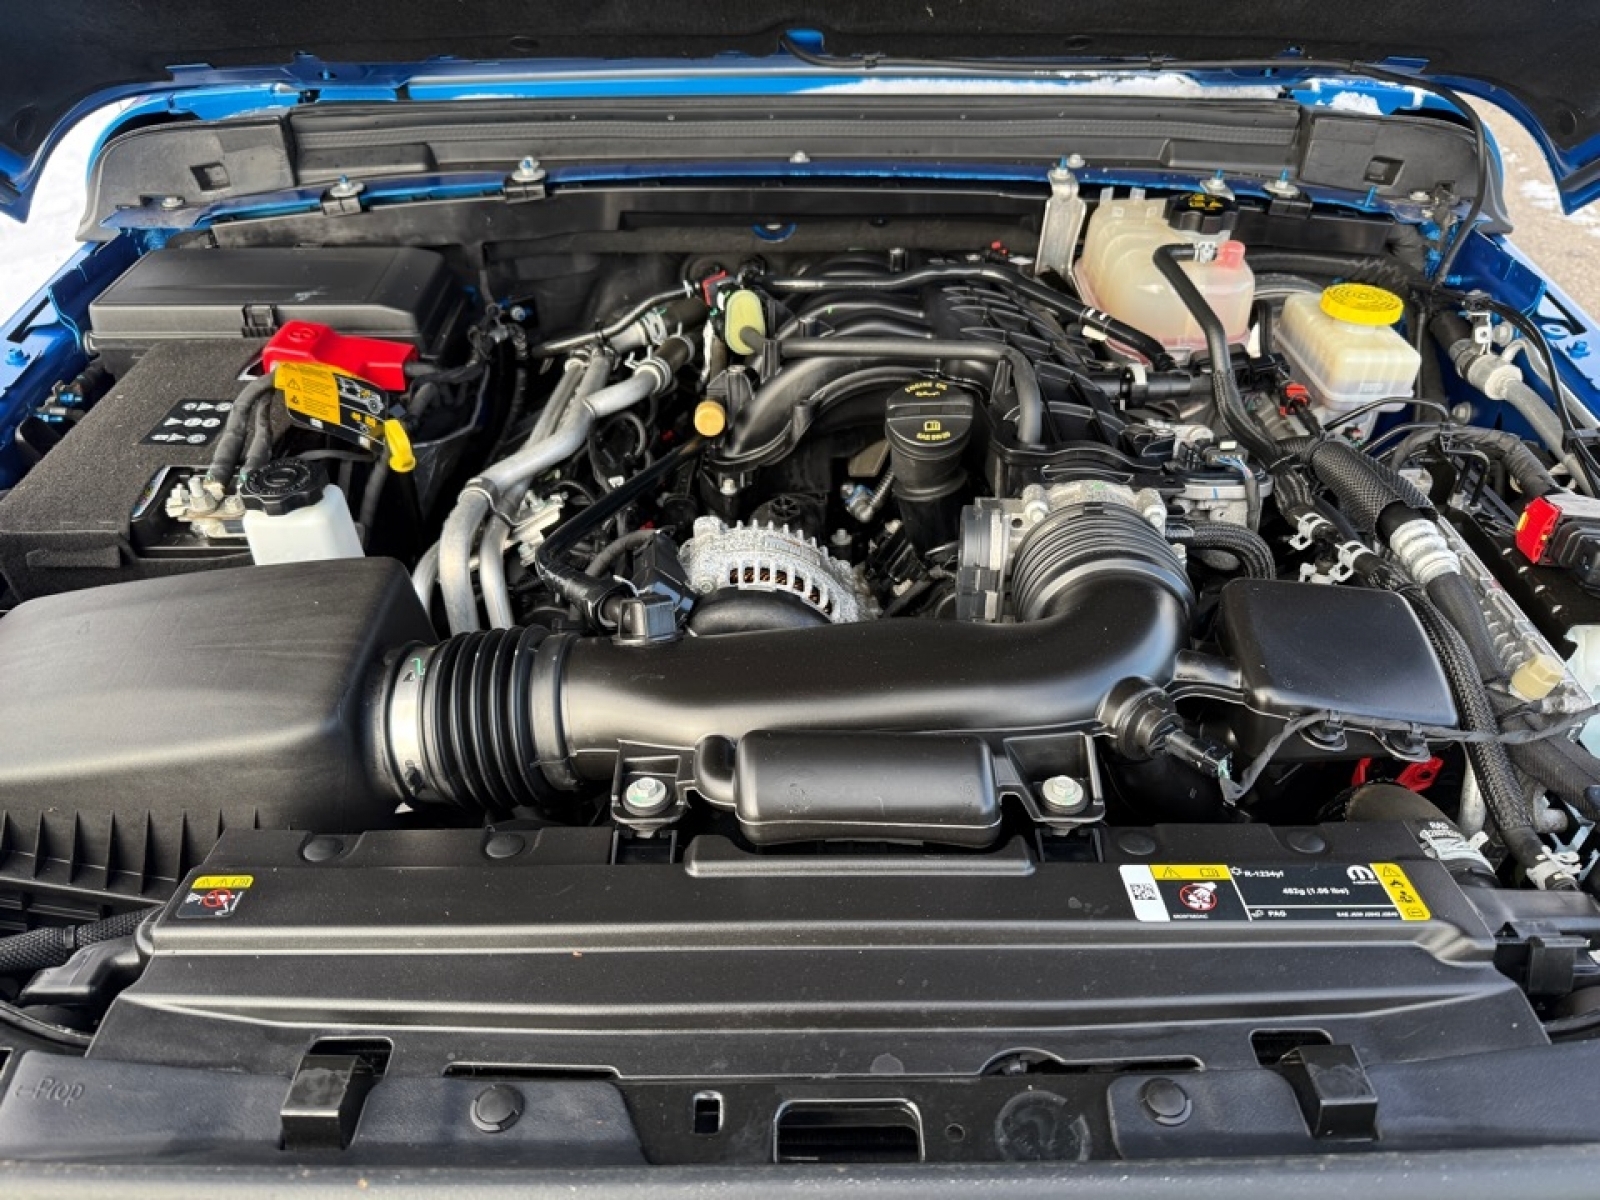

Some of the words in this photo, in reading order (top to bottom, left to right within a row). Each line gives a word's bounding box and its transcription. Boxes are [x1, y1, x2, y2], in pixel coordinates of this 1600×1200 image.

[905, 382, 932, 393] ENGINE
[1244, 869, 1284, 879] R-1234yf
[33, 1076, 86, 1108] Prop
